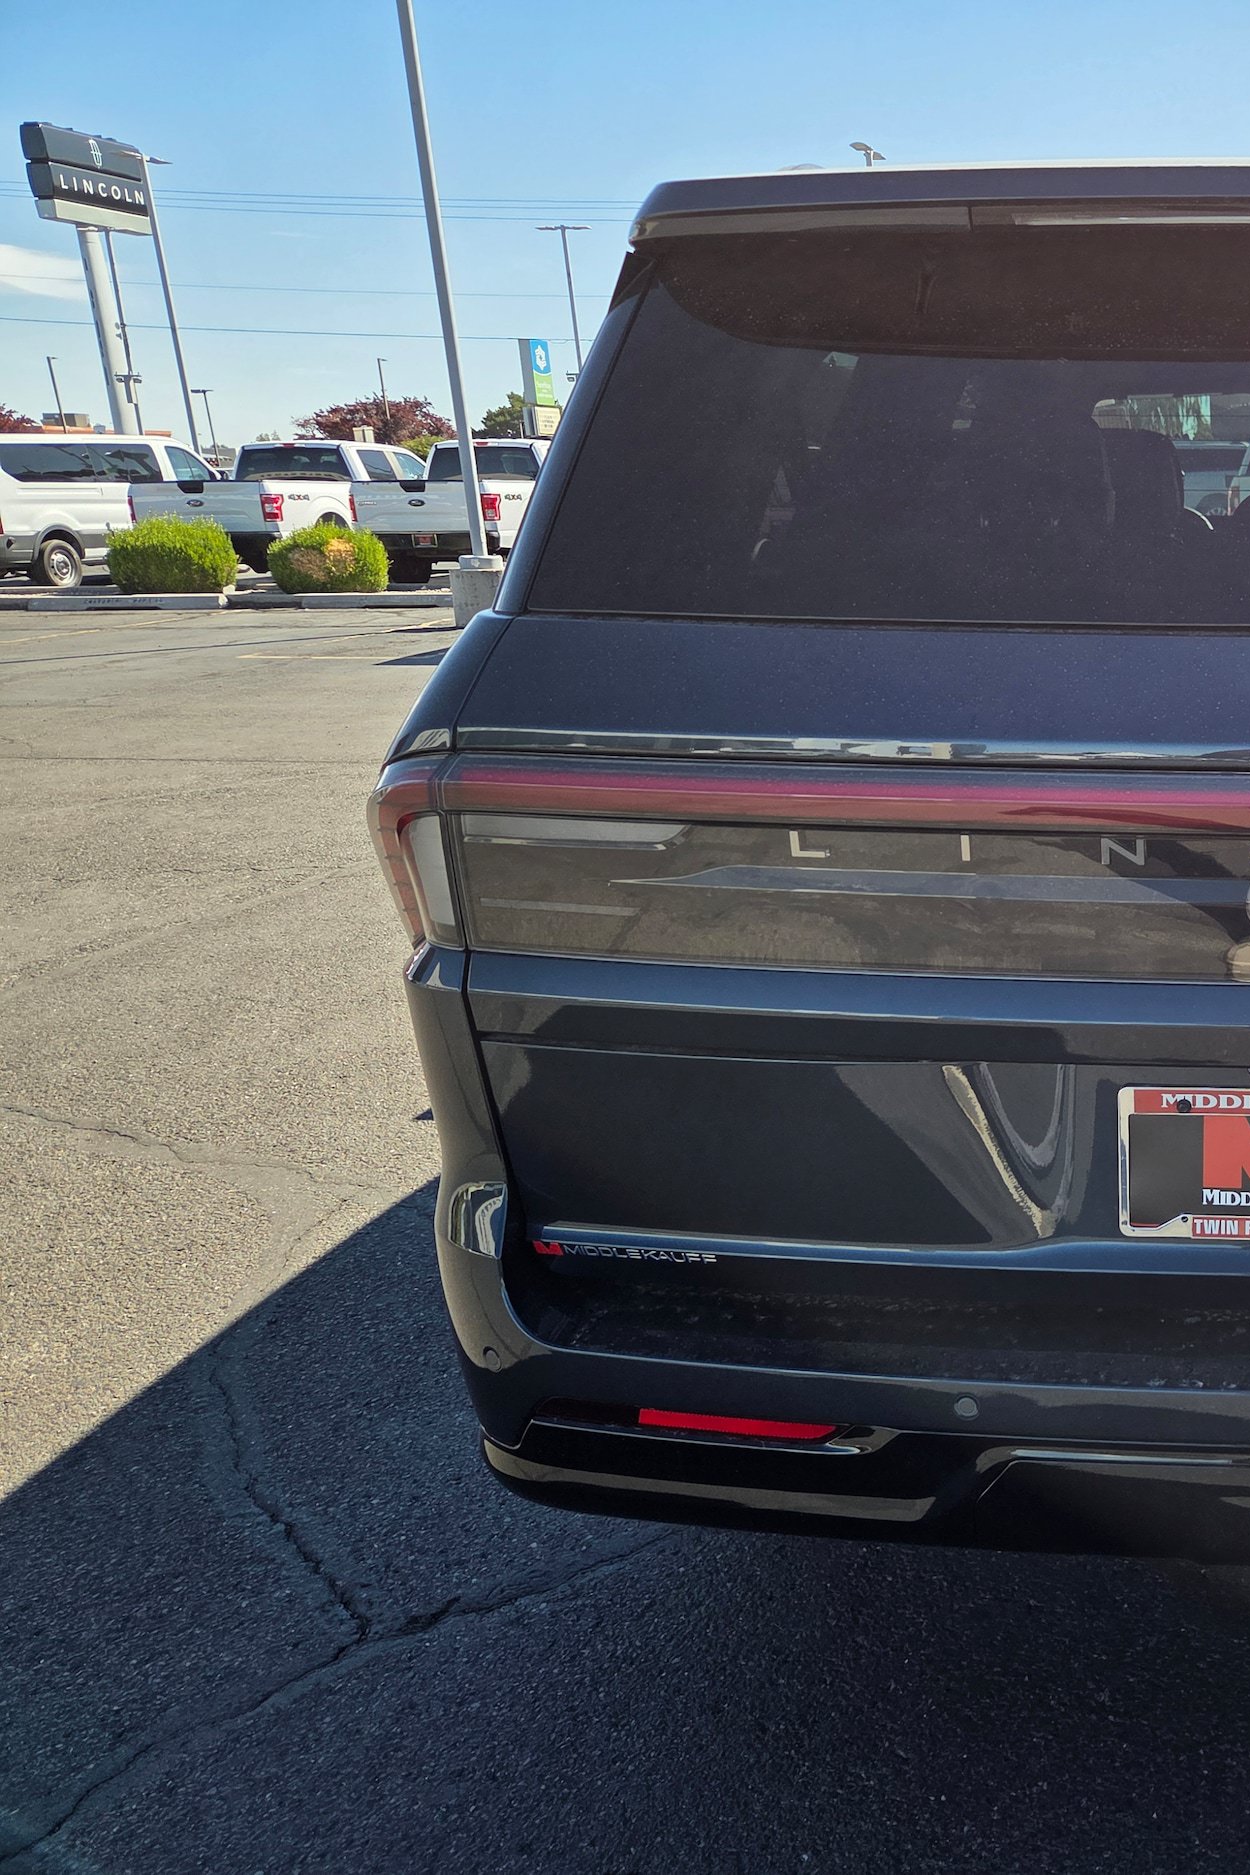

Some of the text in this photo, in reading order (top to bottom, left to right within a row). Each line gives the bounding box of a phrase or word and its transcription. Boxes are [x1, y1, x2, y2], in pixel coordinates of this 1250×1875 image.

[60, 174, 144, 204] LINCOLN
[1193, 1219, 1239, 1236] TWIN
[564, 1245, 717, 1264] MIDDLEKAUFF
